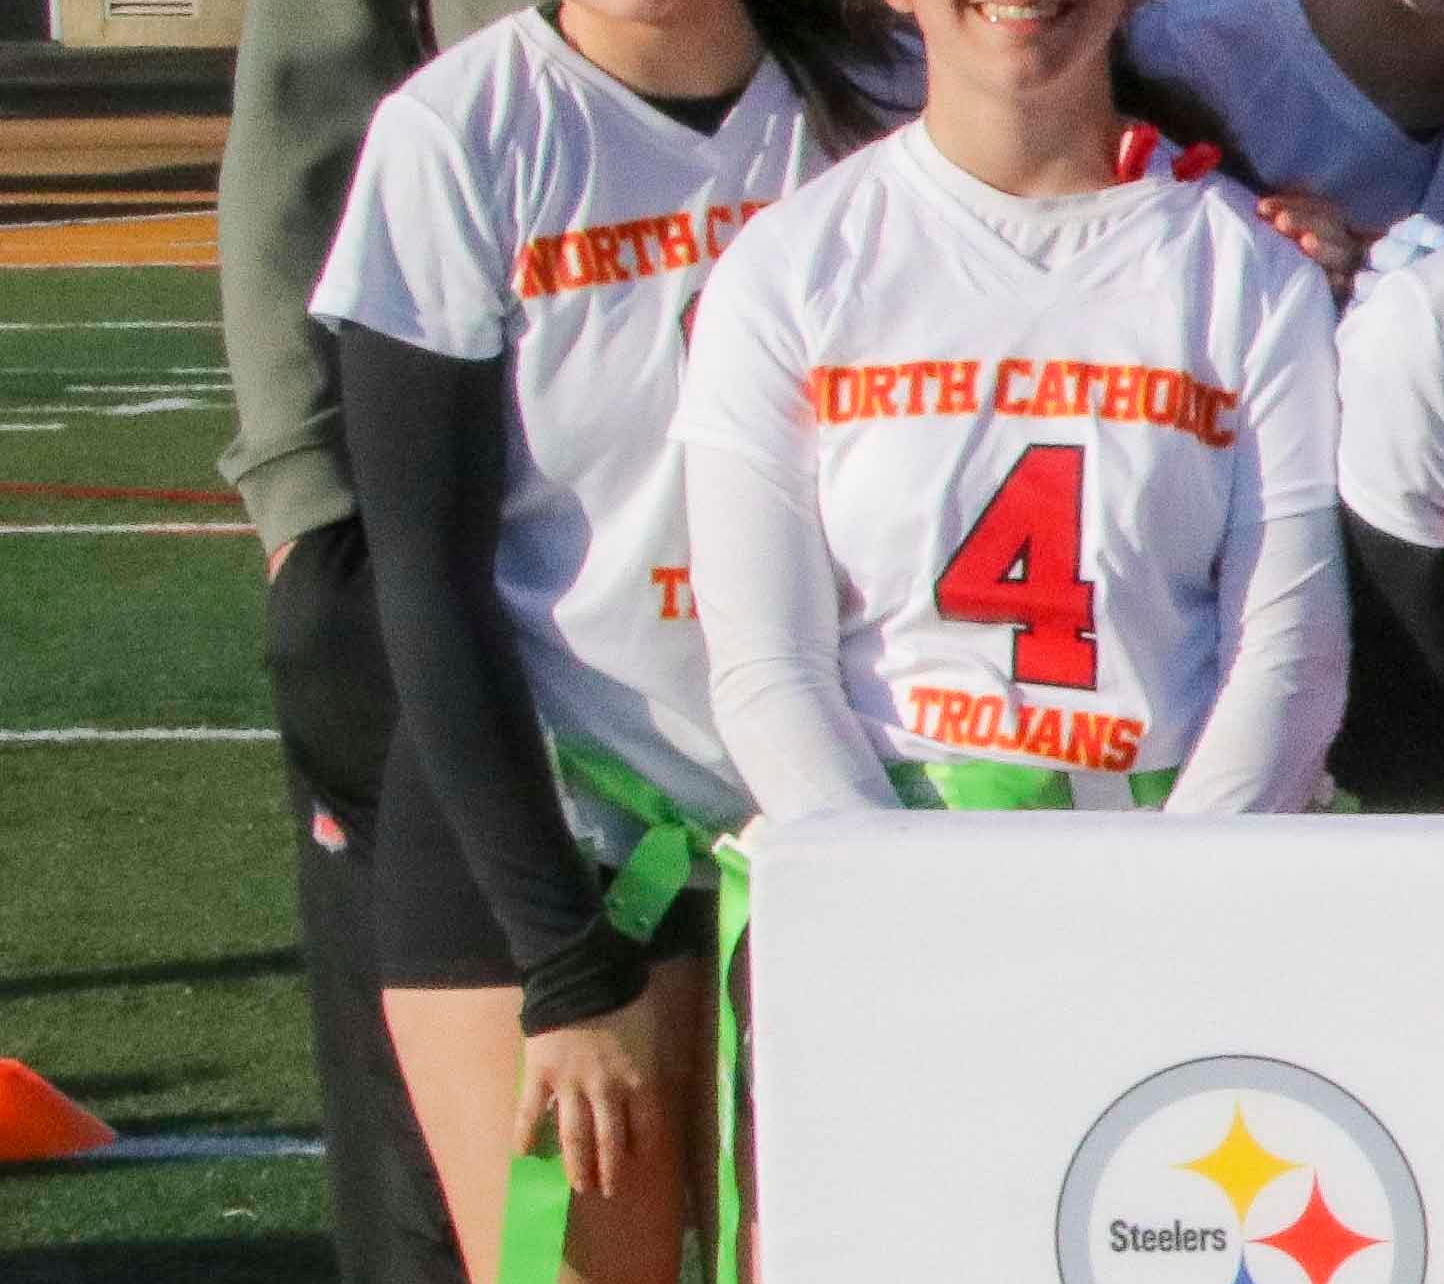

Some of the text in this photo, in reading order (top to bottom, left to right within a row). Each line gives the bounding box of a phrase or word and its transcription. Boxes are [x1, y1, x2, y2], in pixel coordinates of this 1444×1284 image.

[520, 212, 699, 298] NORTH
[934, 443, 1097, 691] 4
[910, 686, 1145, 773] TROJANS
[1109, 1219, 1228, 1253] Steelers
